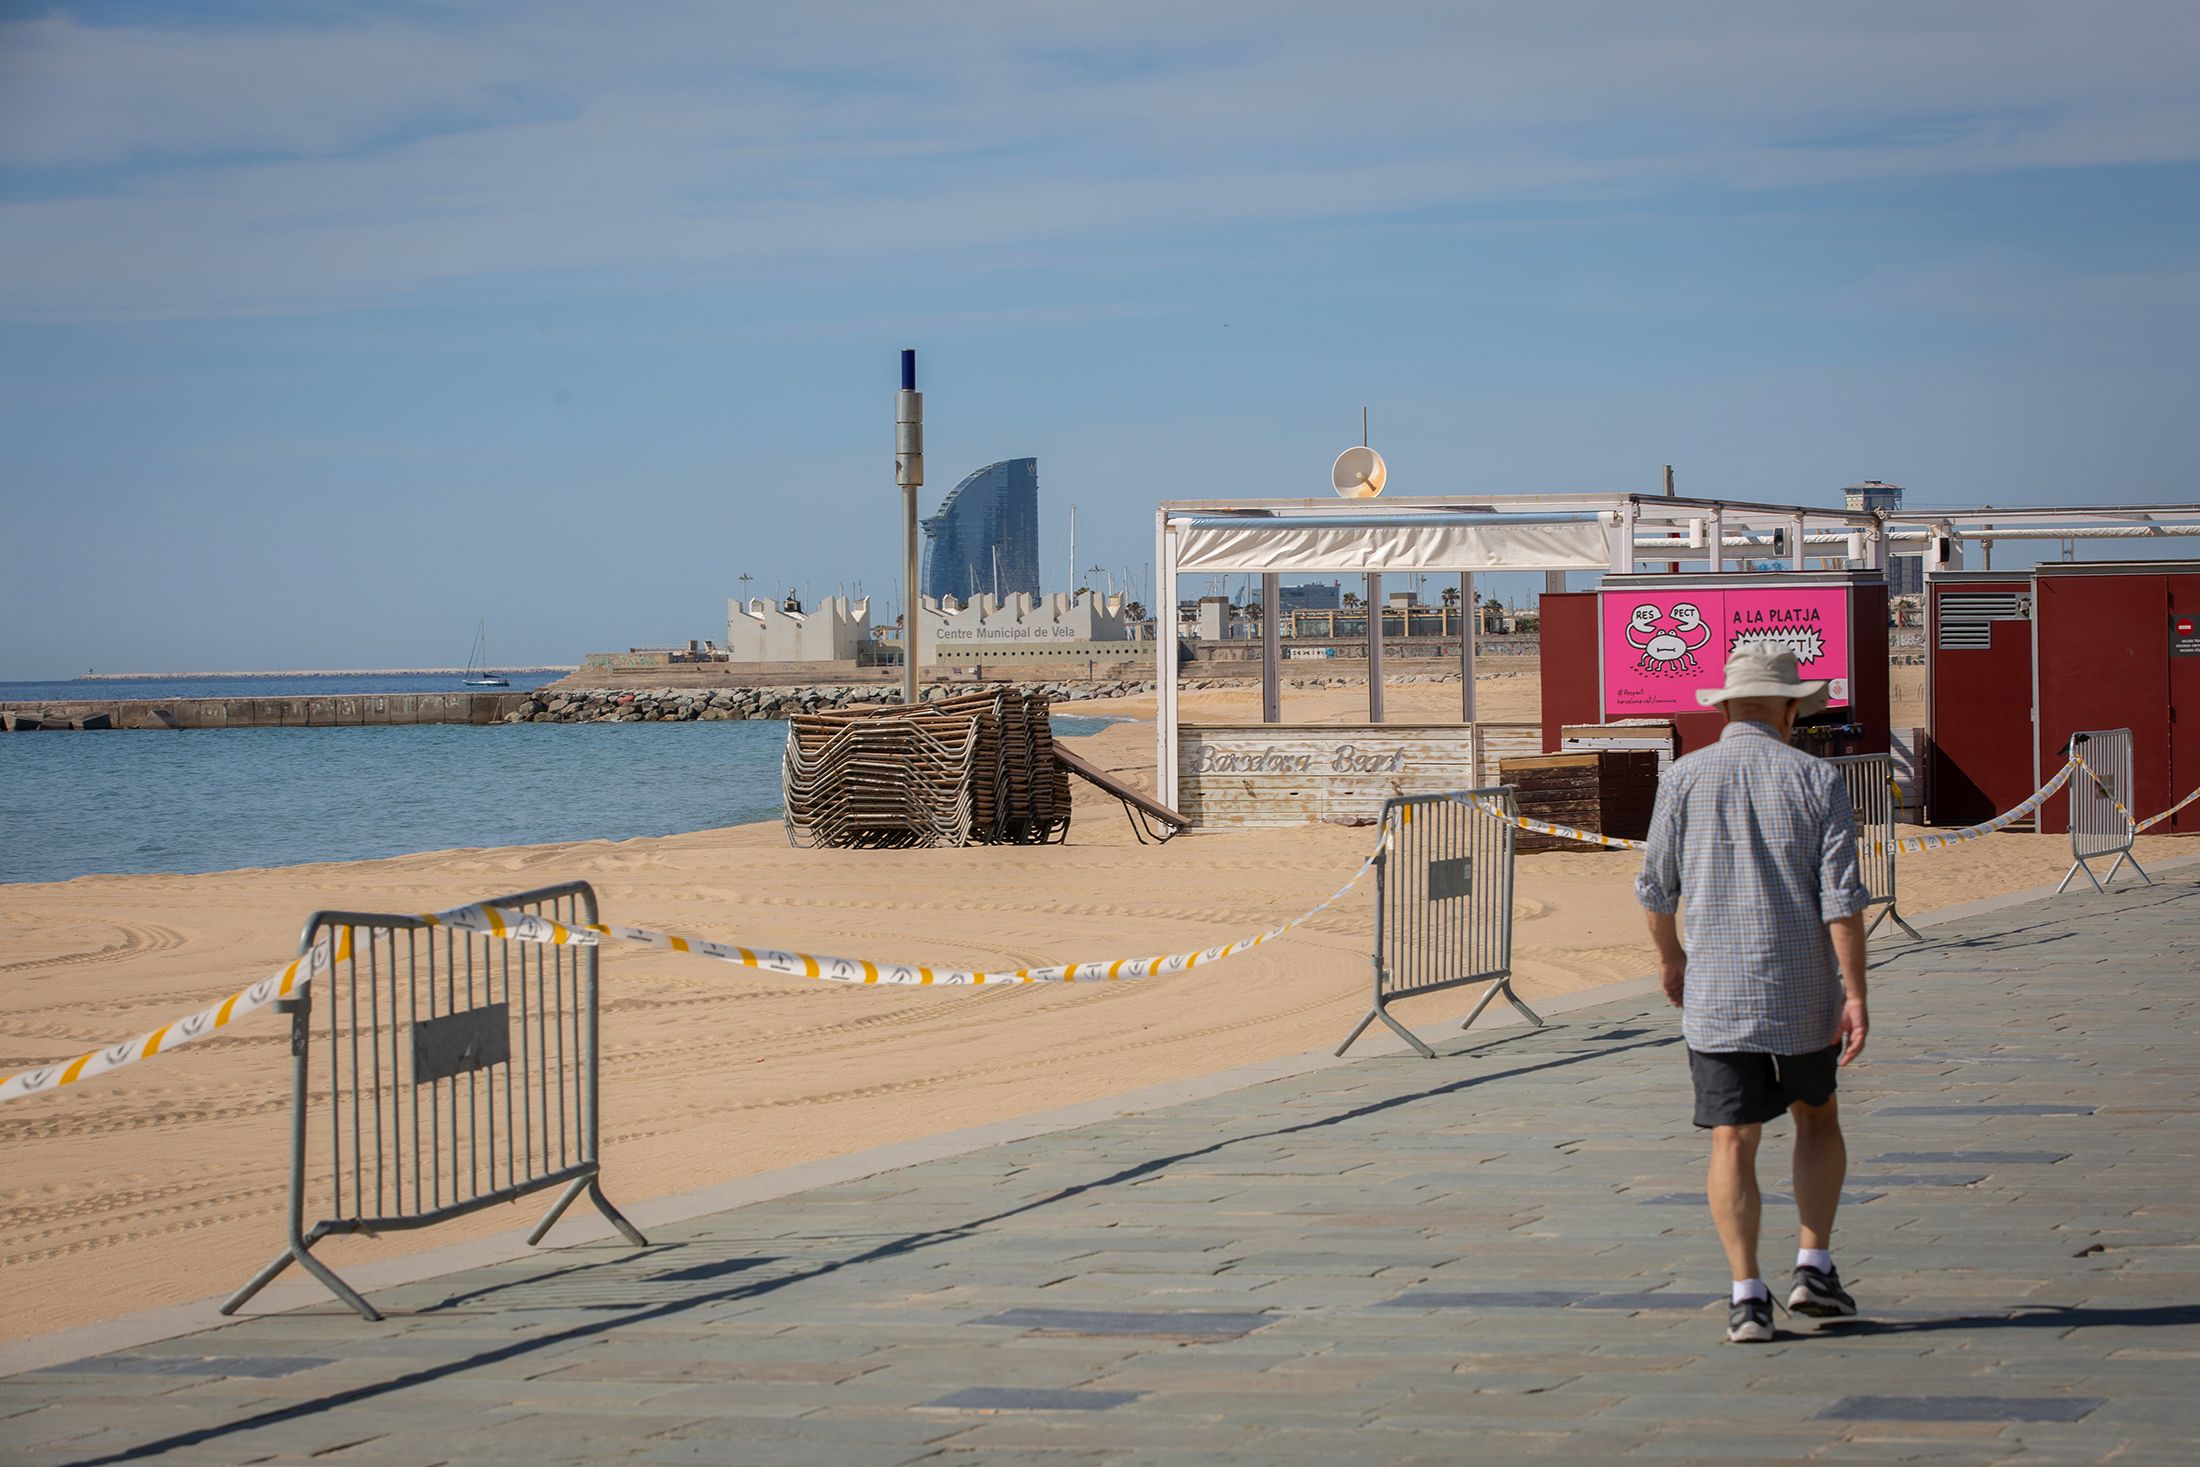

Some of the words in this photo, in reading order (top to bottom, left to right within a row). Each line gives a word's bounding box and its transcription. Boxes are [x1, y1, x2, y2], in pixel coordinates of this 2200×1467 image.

[1636, 610, 1655, 620] RES
[1673, 608, 1695, 618] PECT
[1733, 611, 1742, 624] A
[1746, 609, 1764, 623] LA
[1769, 608, 1820, 622] PLATJA
[936, 628, 973, 640] Centre
[976, 626, 1031, 640] Municipal
[1034, 626, 1048, 638] de
[1051, 626, 1075, 638] Vela
